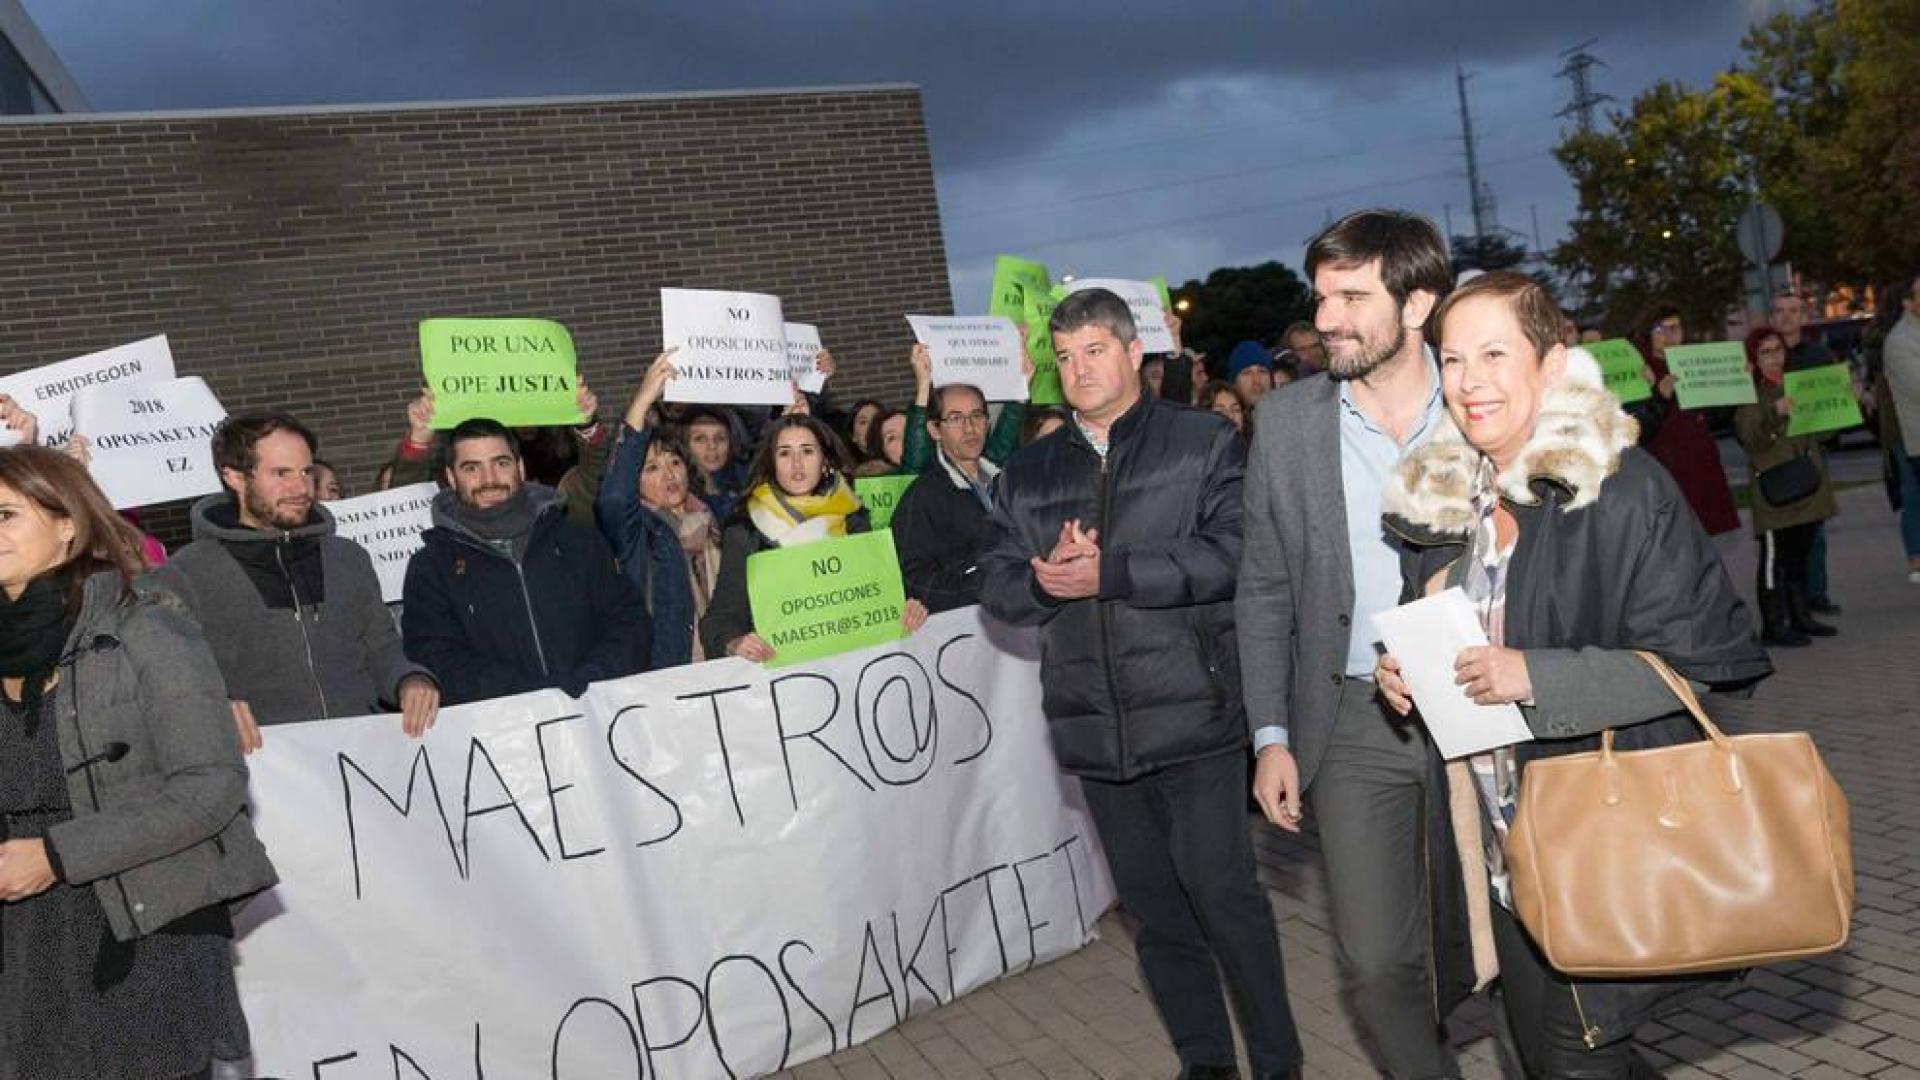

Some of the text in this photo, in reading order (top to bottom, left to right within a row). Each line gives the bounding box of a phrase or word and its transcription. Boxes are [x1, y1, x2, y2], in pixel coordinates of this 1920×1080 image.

[728, 307, 751, 321] NO
[450, 335, 556, 353] POR UNA
[687, 335, 784, 352] OPOSICIONES
[679, 365, 765, 381] MAESTROS
[441, 375, 569, 393] OPE JUSTA
[127, 399, 166, 415] 2018
[165, 456, 193, 474] EZ
[871, 491, 893, 508] NO
[811, 555, 843, 577] NO
[780, 581, 882, 616] OPOSICIONES
[771, 606, 901, 647] MAESTR@S 2018
[337, 633, 994, 900] MAESTR@S
